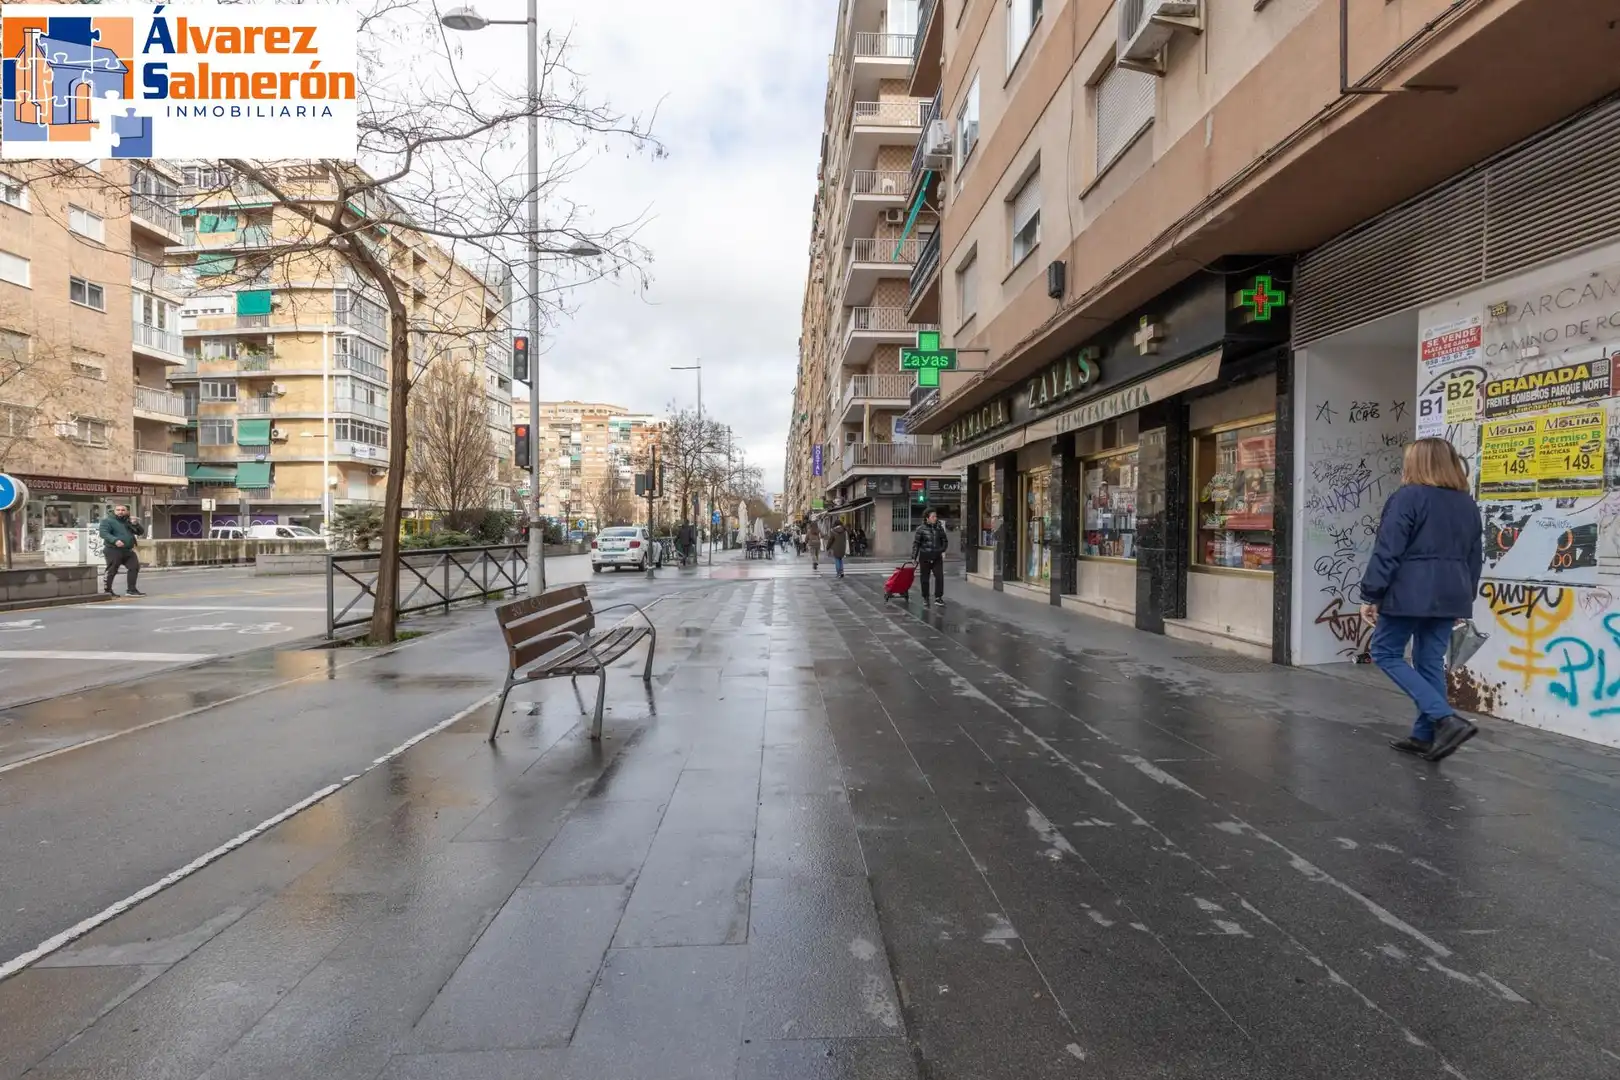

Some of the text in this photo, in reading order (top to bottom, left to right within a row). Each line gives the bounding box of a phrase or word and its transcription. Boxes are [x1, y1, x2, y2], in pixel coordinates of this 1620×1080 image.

[1426, 327, 1476, 348] SE VENDE
[1485, 327, 1558, 357] CAMINO
[1565, 319, 1589, 338] DE
[903, 352, 949, 367] Zayas
[1028, 347, 1093, 409] ZAYAS
[1486, 364, 1590, 397] GRANADA
[1447, 379, 1475, 401] B2
[1486, 396, 1511, 409] FRENTE
[1551, 381, 1581, 398] PARQUE
[1582, 377, 1609, 391] NORTE
[1420, 396, 1443, 416] B1
[1488, 425, 1535, 436] MOLINA
[1544, 416, 1600, 431] MOLINA
[1485, 437, 1535, 450] Permiso B
[1541, 430, 1601, 444] Permiso B
[25, 479, 62, 490] PRODUCTOS
[63, 482, 72, 490] DE
